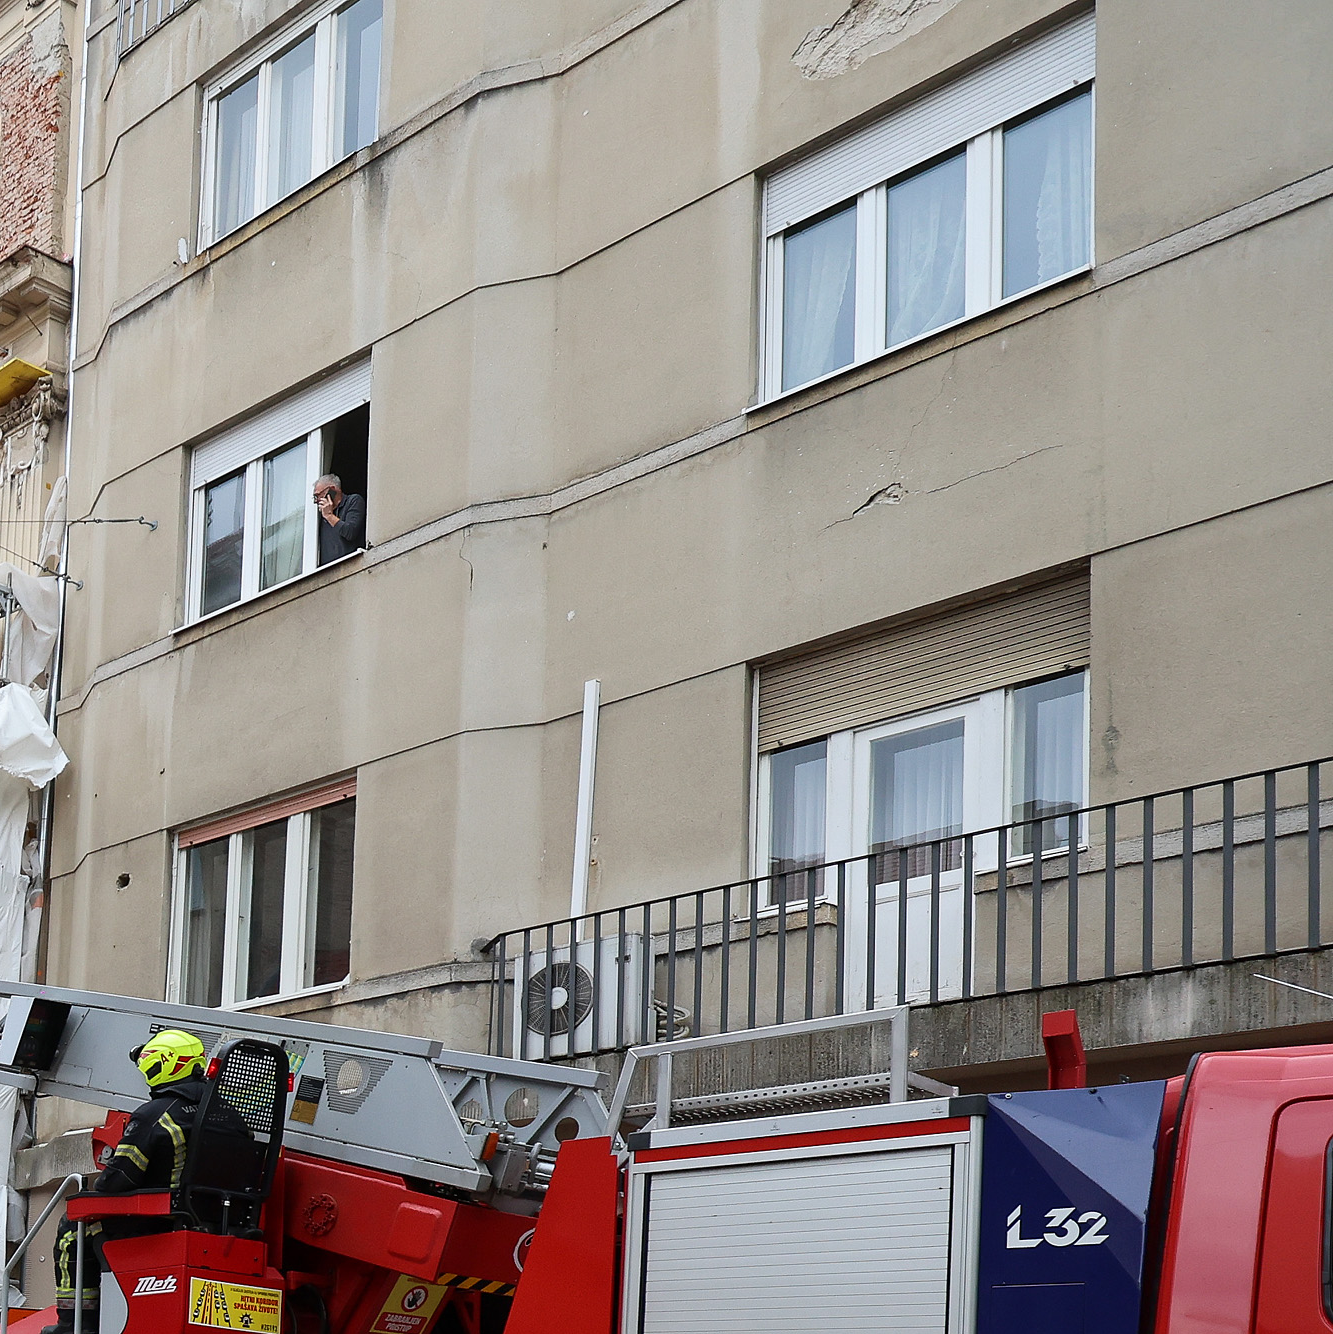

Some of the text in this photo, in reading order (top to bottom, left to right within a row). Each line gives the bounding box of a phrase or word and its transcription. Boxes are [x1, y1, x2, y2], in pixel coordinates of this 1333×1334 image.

[1005, 1204, 1110, 1249] L32
[131, 1275, 177, 1297] Metz
[234, 1302, 258, 1312] SPAŠAVA
[384, 1313, 422, 1325] ZABRANJEN
[385, 1323, 413, 1332] PRISTUP
